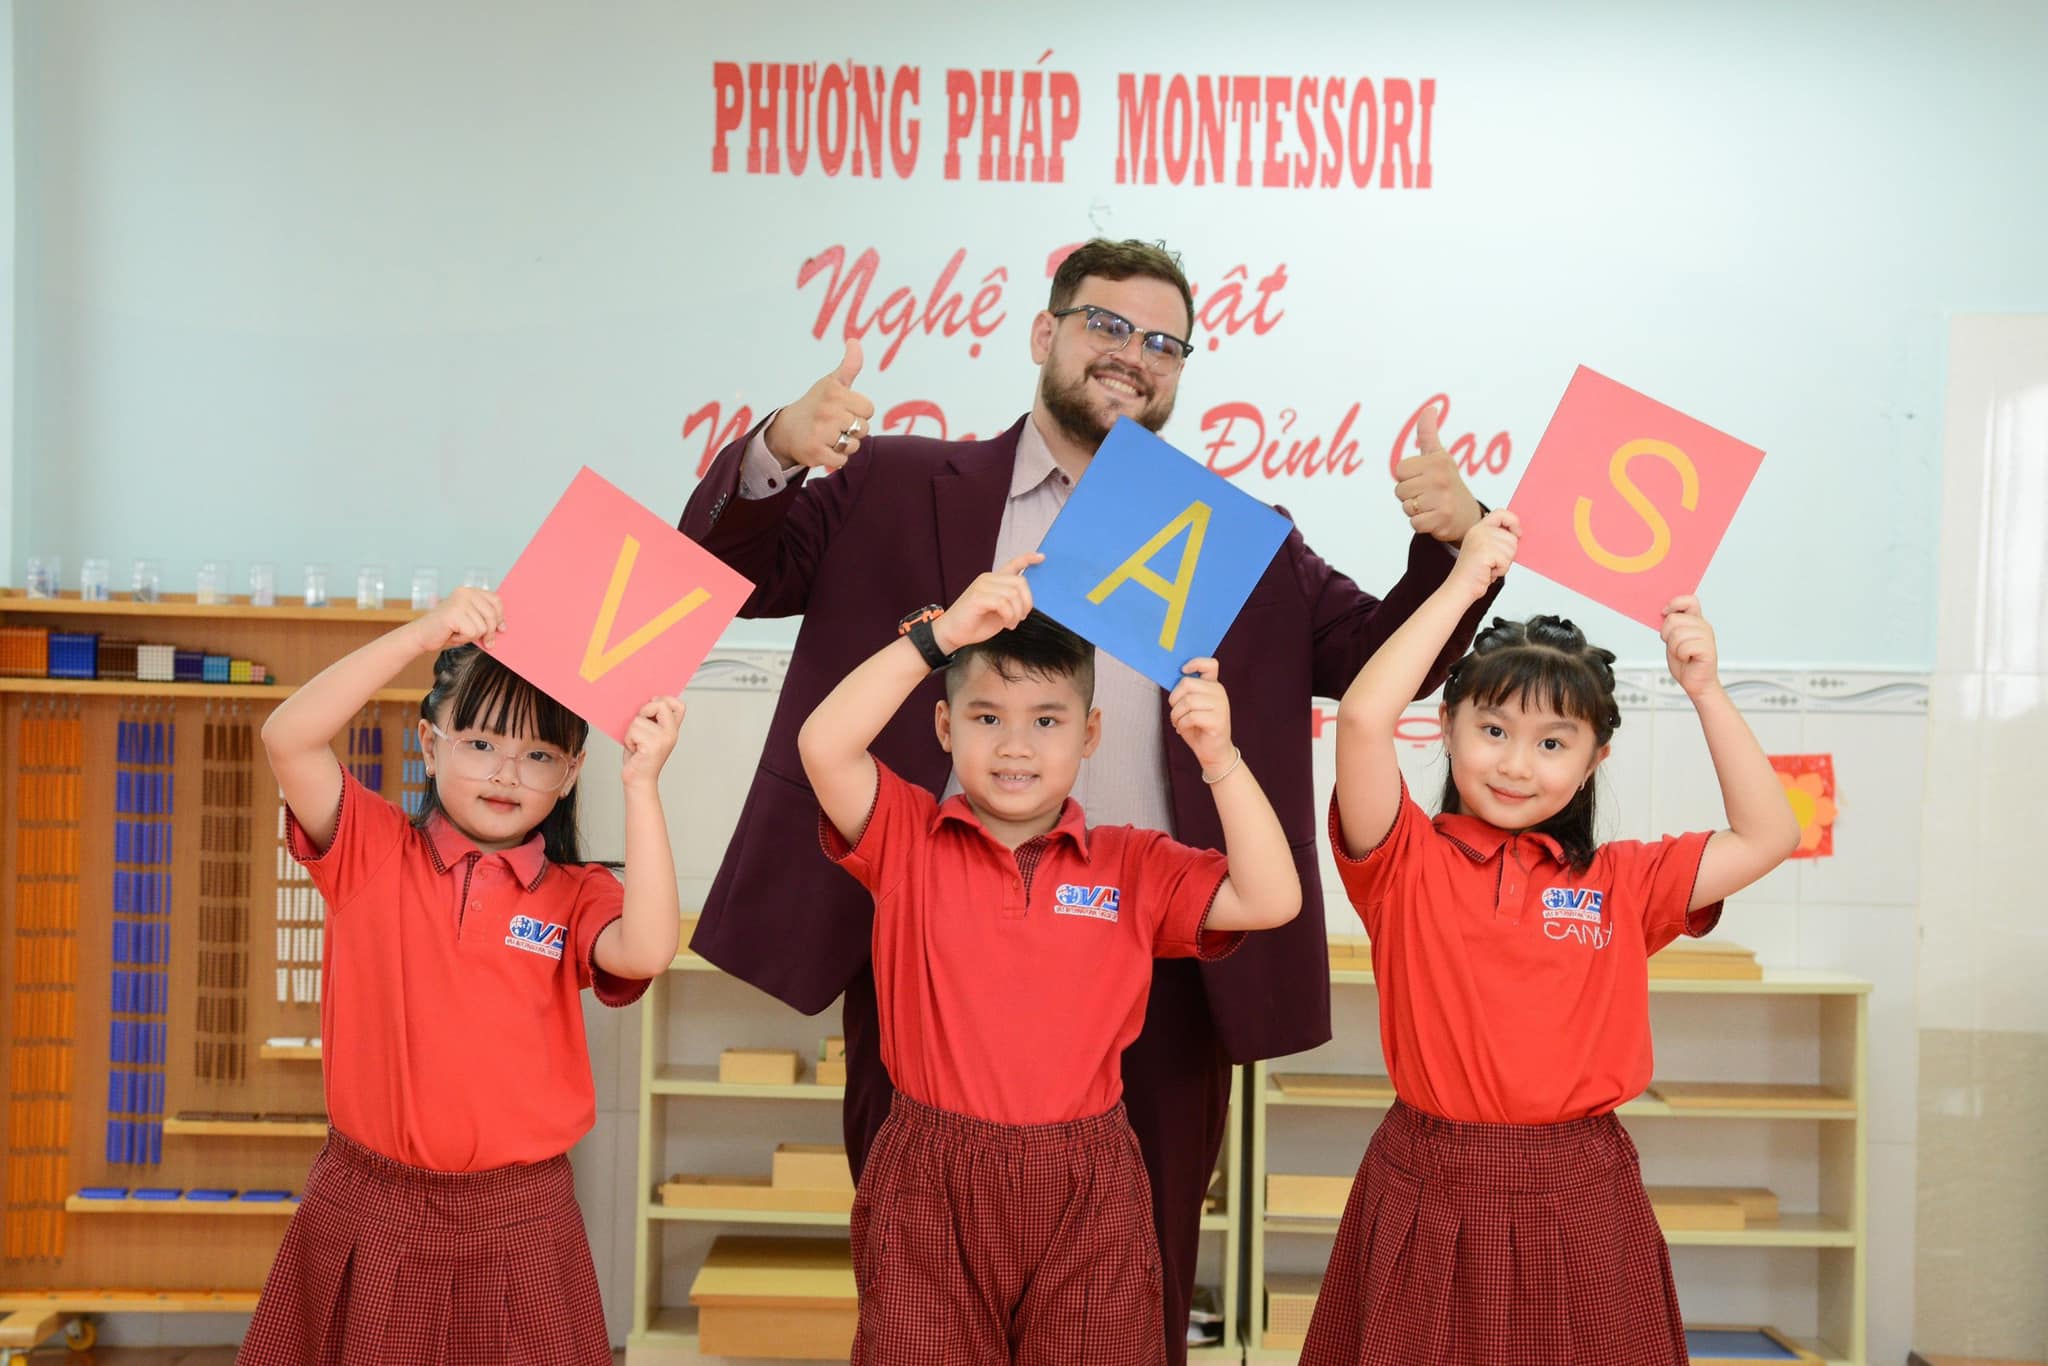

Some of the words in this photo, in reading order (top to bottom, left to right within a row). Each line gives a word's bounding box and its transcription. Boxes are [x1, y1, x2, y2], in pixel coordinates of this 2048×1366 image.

[711, 58, 921, 180] PHƯƠNG
[943, 48, 1081, 183] PHÁP
[1115, 73, 1437, 189] MONTESSORI
[796, 244, 1008, 372] Nghệ
[1200, 401, 1364, 480] Đỉnh
[1388, 392, 1512, 482] Cao
[1574, 438, 1699, 574] S
[581, 535, 711, 684] V
[1087, 501, 1211, 651] A
